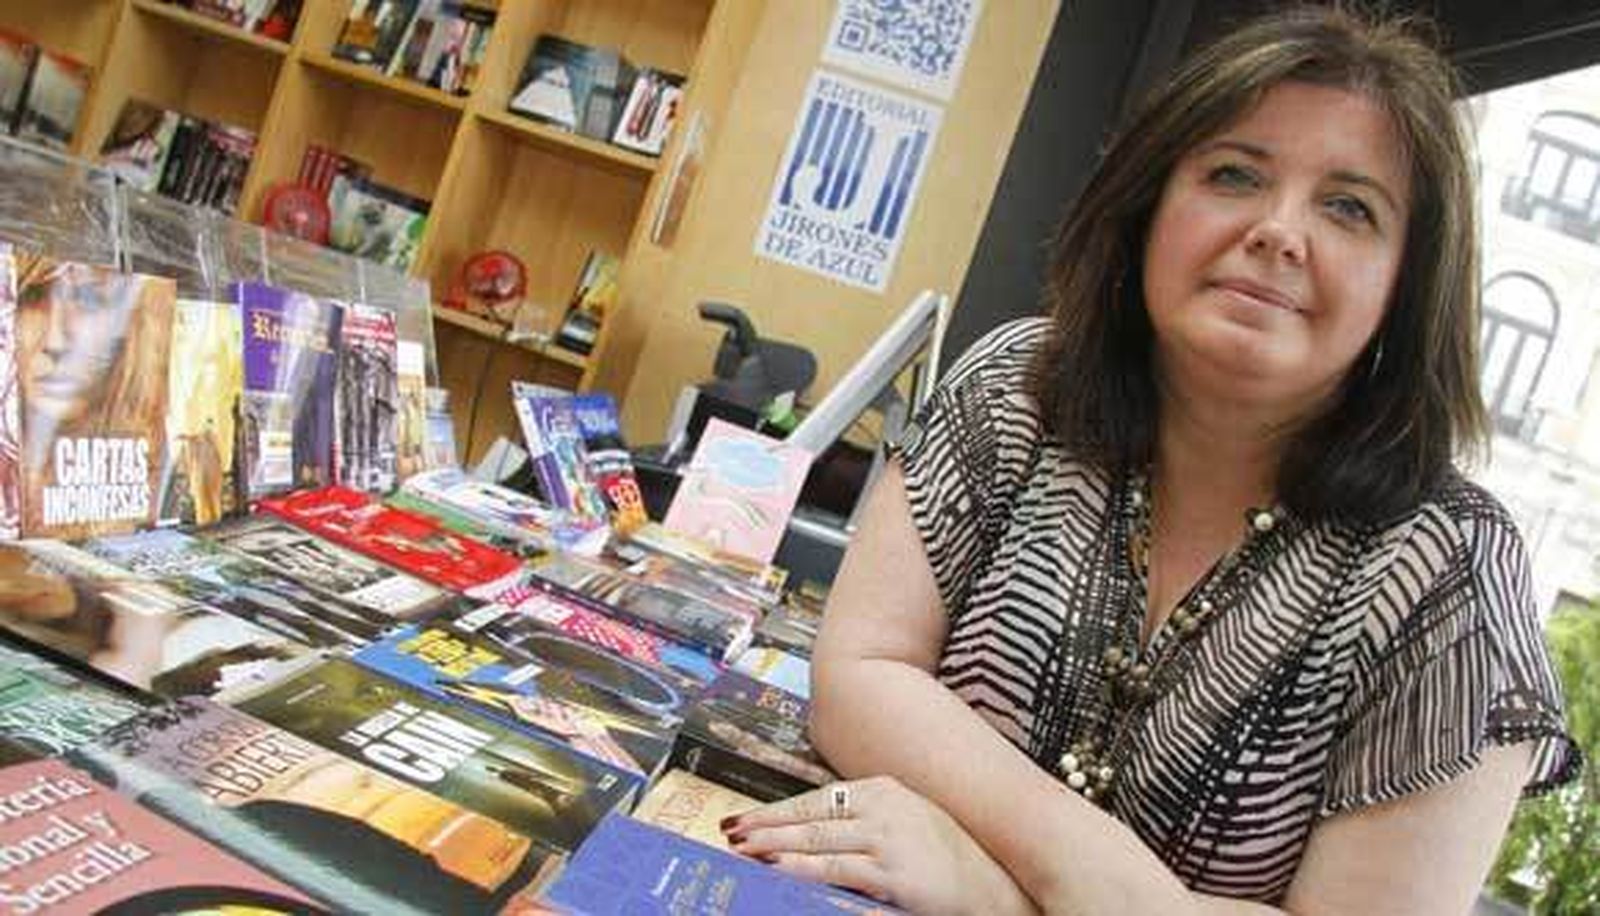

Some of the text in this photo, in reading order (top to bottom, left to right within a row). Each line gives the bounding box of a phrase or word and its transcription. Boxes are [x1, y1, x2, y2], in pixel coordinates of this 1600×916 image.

[815, 77, 927, 126] EDITORIAL
[765, 231, 879, 286] DE AZUL
[769, 209, 888, 261] JIRONES
[56, 437, 150, 487] CARTAS
[43, 484, 150, 525] INCONFESAS
[82, 811, 117, 837] y
[0, 841, 152, 914] Sencilla
